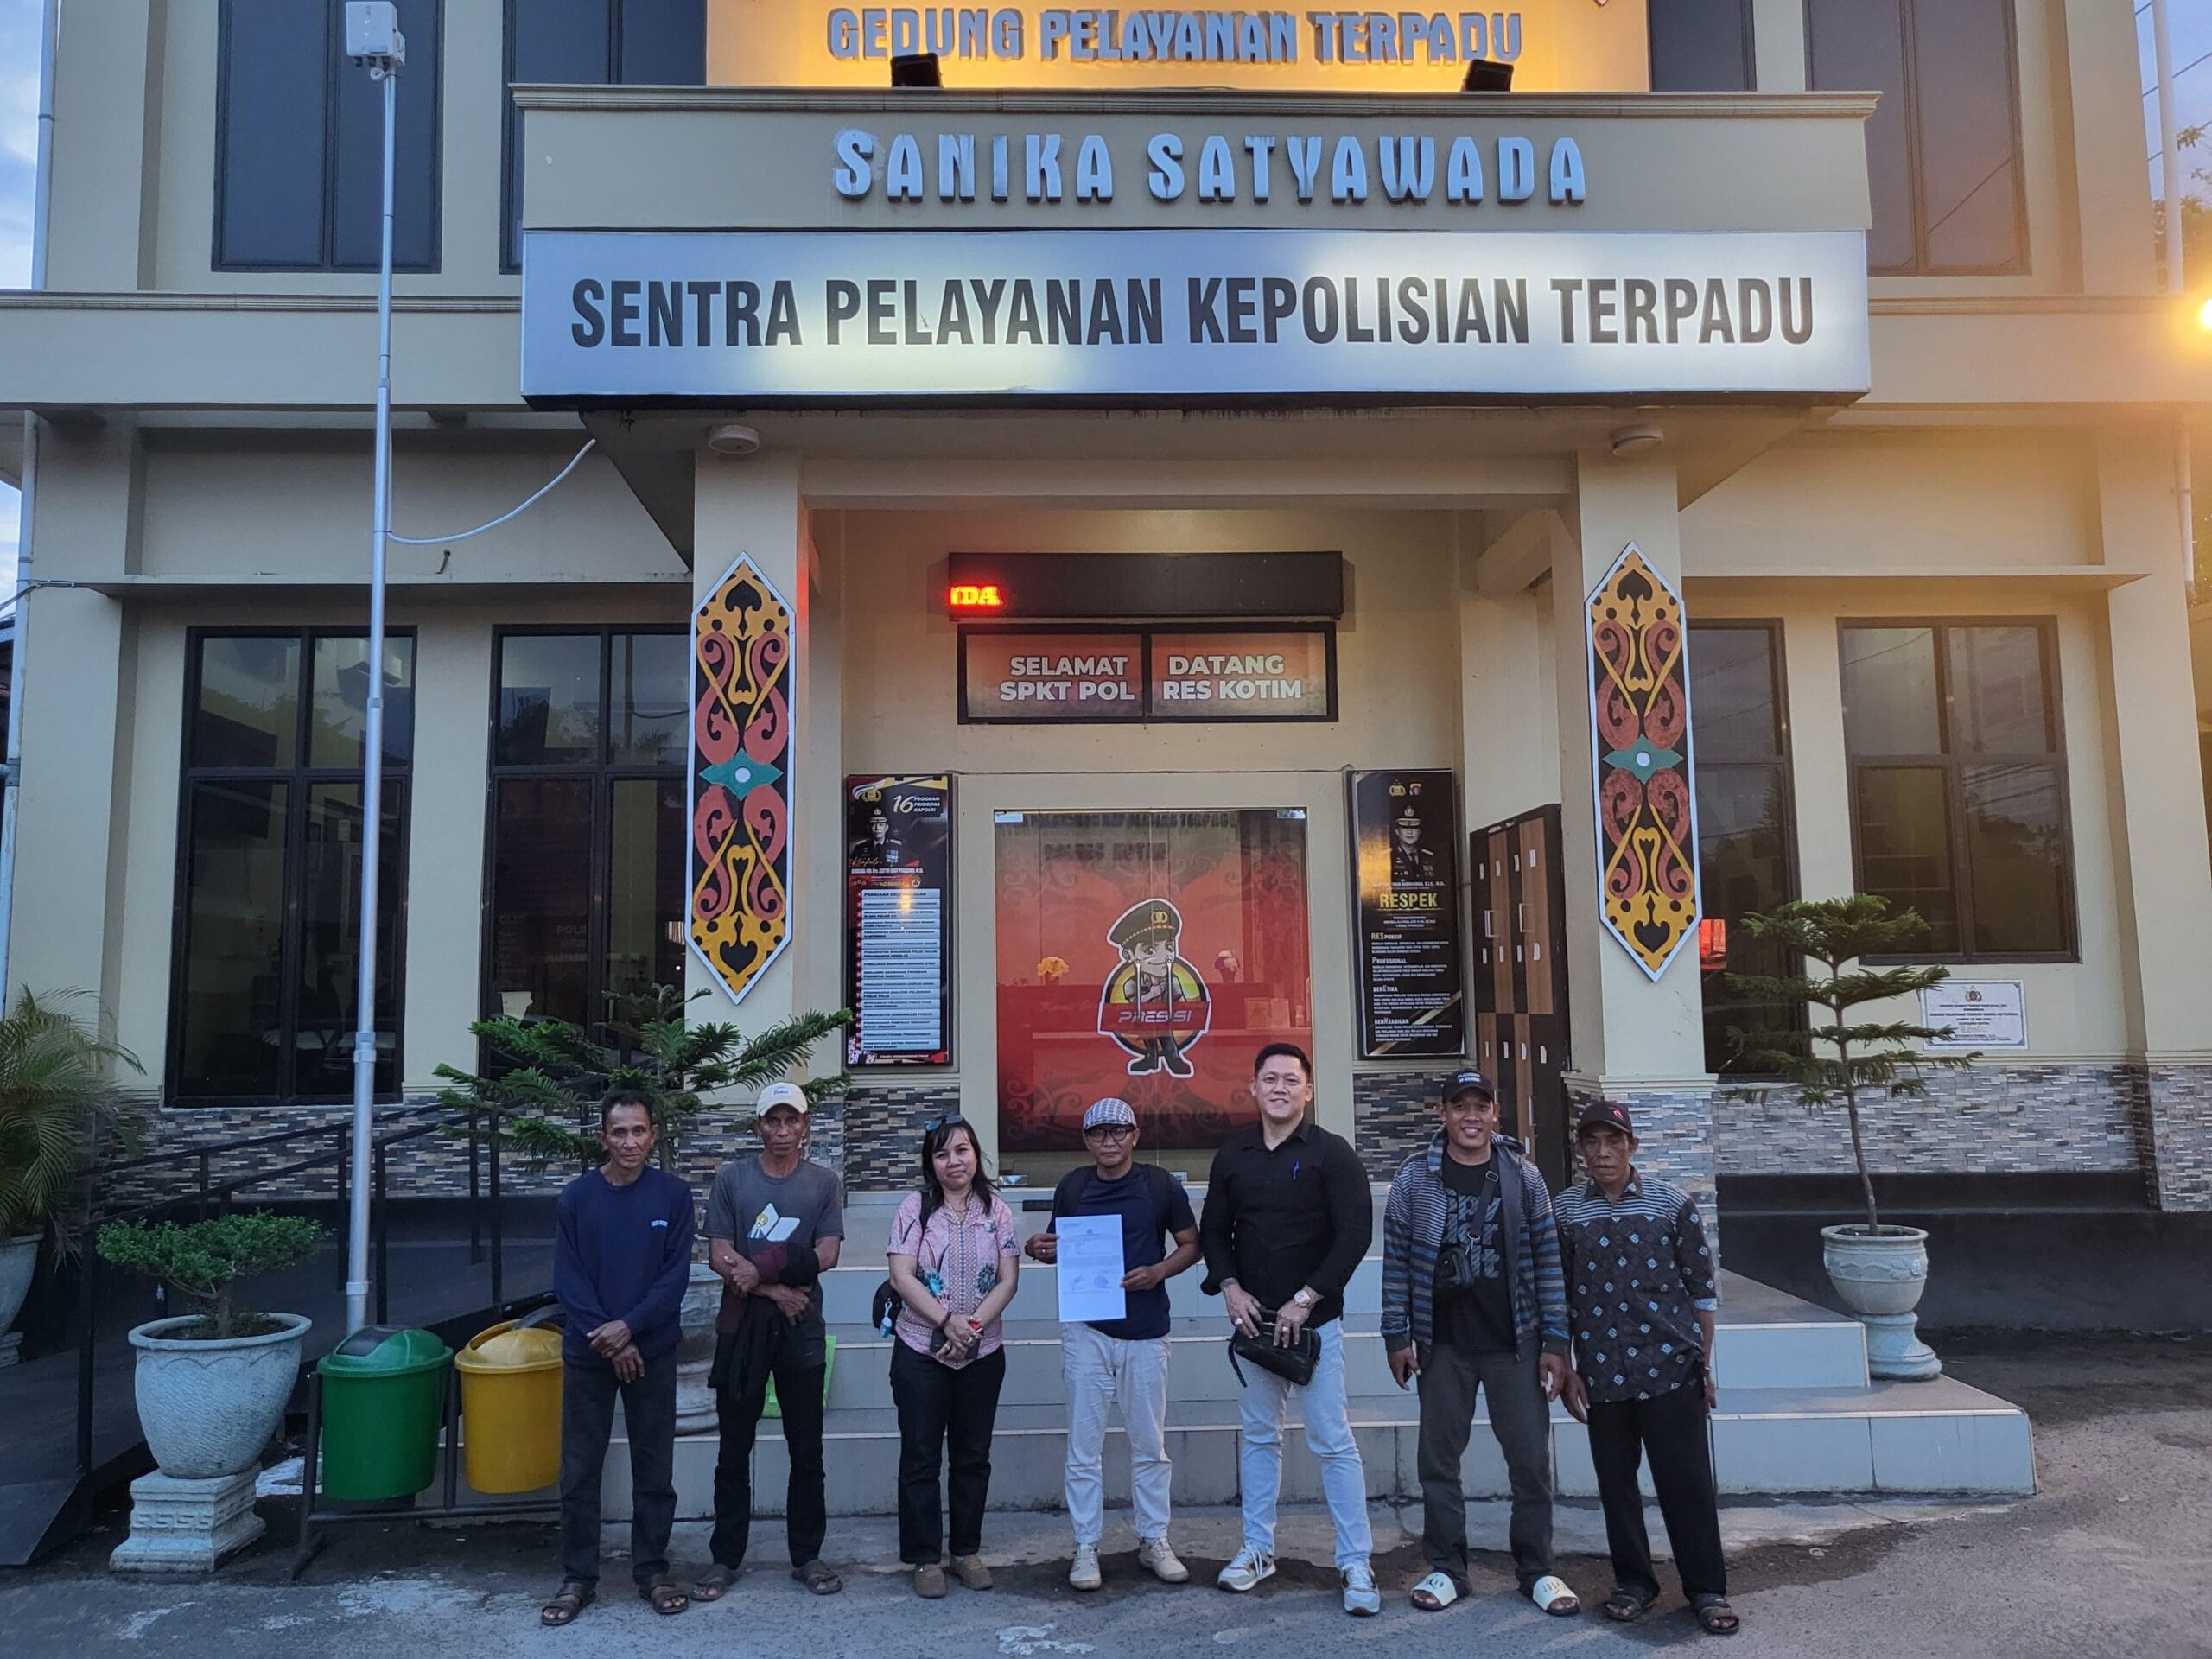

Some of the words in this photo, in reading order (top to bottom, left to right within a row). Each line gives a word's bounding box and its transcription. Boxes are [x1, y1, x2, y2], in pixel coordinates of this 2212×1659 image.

[828, 8, 1023, 60] GEDUNG
[1040, 12, 1297, 61] PELAYANAN
[1314, 12, 1522, 62] TERPADU
[836, 130, 1113, 202] SANIKA
[1148, 133, 1586, 204] SATYAWADA
[571, 278, 802, 347] SENTRA
[825, 277, 1163, 346] PELAYANAN
[1189, 275, 1529, 345] KEPOLISIAN
[1551, 276, 1813, 345] TERPADU
[1010, 656, 1128, 676] SELAMAT
[1169, 654, 1284, 675] DATANG
[1000, 680, 1071, 701] SPKT
[1079, 680, 1135, 701] POL
[1163, 680, 1211, 701] RES
[1219, 679, 1301, 700] KOTIM
[893, 794, 915, 813] 16
[1379, 893, 1438, 908] RESPEK
[1118, 1009, 1192, 1023] PRESSI
